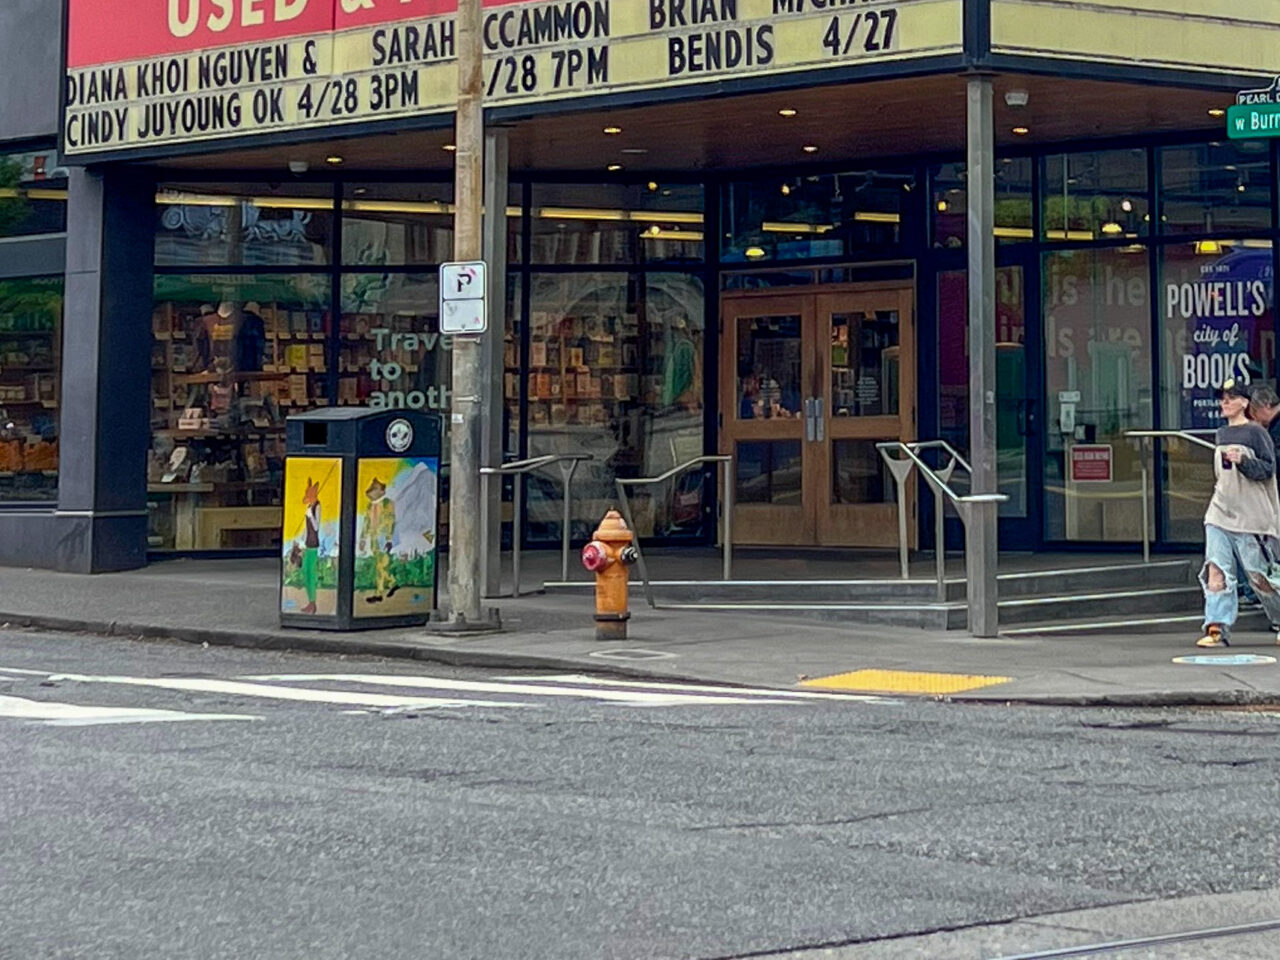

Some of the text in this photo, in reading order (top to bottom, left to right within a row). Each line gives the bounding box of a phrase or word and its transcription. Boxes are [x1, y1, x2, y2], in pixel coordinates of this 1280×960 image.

[372, 0, 610, 66] SARAH CCAMMON
[668, 8, 898, 76] BENDIS 4/27
[66, 40, 317, 107] DIANA KHOI NGUYEN &
[481, 45, 609, 96] /28 7PM
[67, 70, 419, 147] CINDY JUYOUNG OK 4/28 3PM
[1239, 93, 1271, 104] PEARL
[1235, 118, 1244, 131] W
[1167, 281, 1265, 318] POWELL'S
[370, 327, 453, 352] Trave
[1193, 324, 1219, 347] city
[1223, 323, 1239, 347] of
[369, 358, 402, 381] to
[1183, 352, 1251, 389] BOOKS
